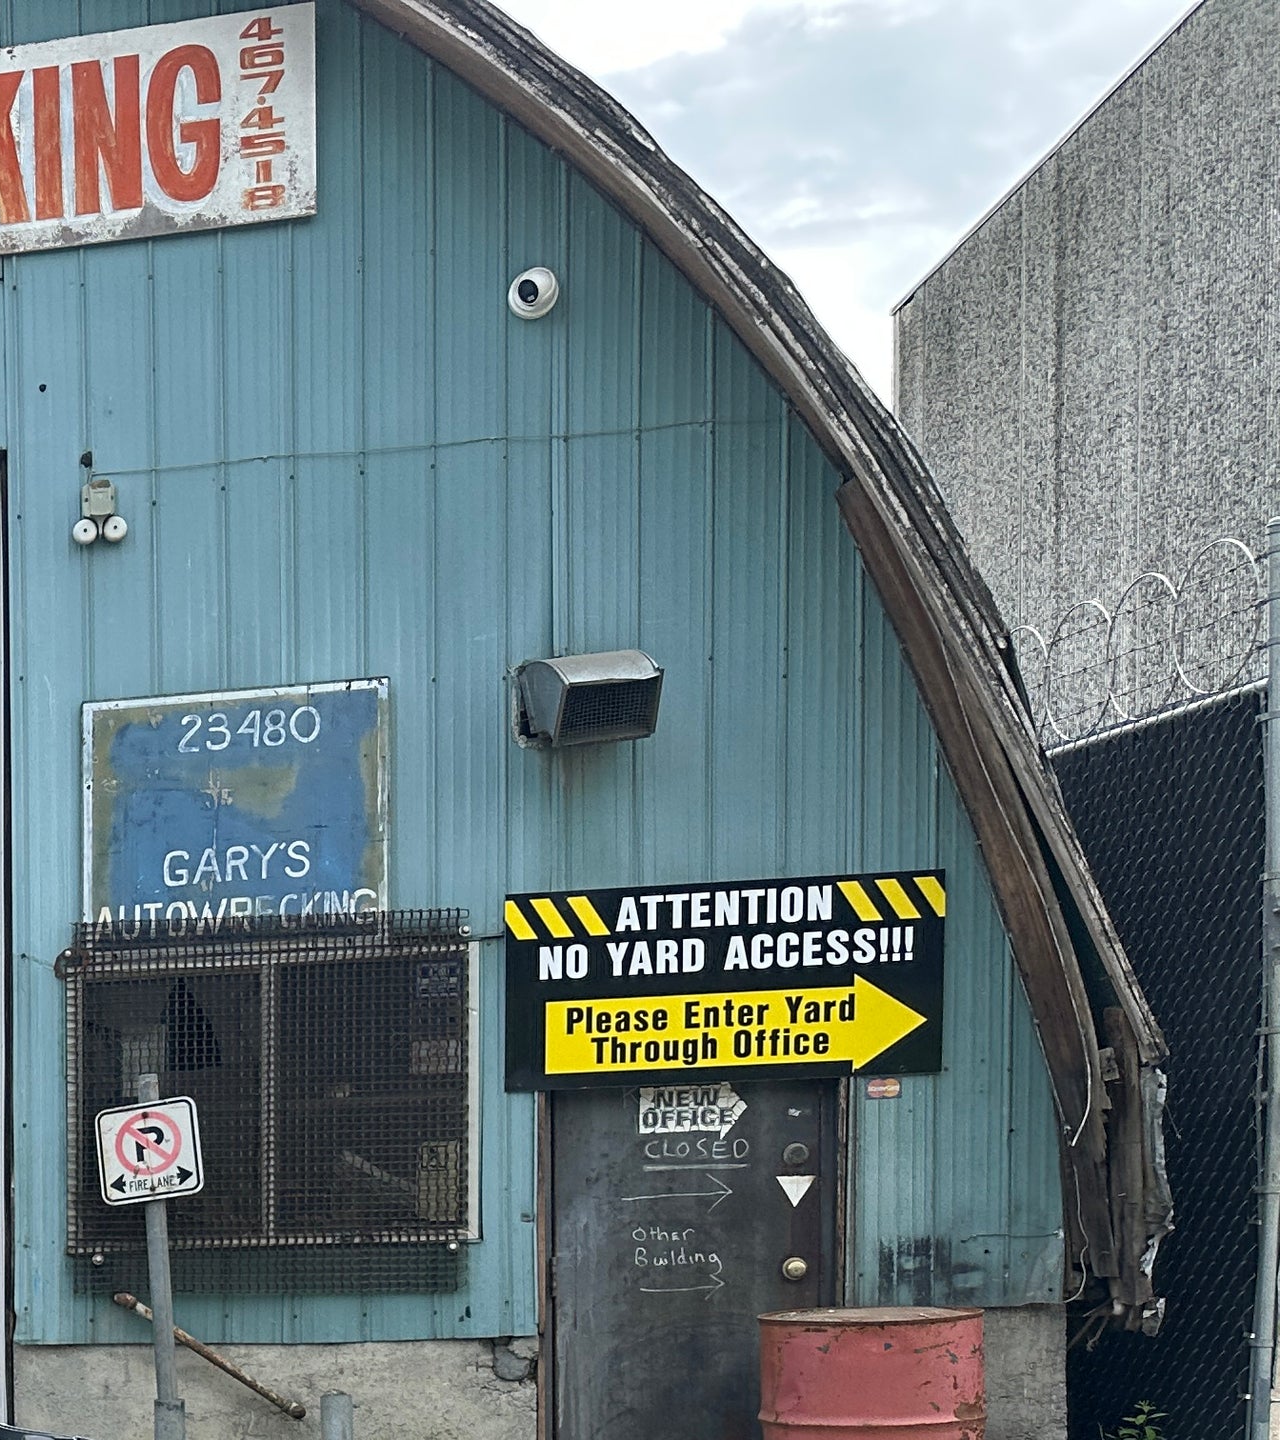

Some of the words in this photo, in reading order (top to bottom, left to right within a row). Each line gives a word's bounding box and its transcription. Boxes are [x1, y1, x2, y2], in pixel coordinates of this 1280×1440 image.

[177, 704, 322, 754] 23480
[162, 839, 312, 888] GARY'S
[615, 884, 833, 932] ATTENTION
[539, 943, 588, 981] NO
[606, 938, 705, 977] YARD
[723, 926, 915, 971] ACCESS!!!
[565, 1005, 668, 1035] Please
[684, 1000, 770, 1028] Enter
[785, 993, 856, 1023] Yard
[591, 1034, 718, 1067] Through
[733, 1027, 830, 1058] Office
[654, 1088, 719, 1107] NEW
[642, 1108, 734, 1129] OFFICE
[644, 1138, 750, 1159] CLOSED
[129, 1178, 149, 1193] FIRE
[634, 1248, 724, 1276] Building
